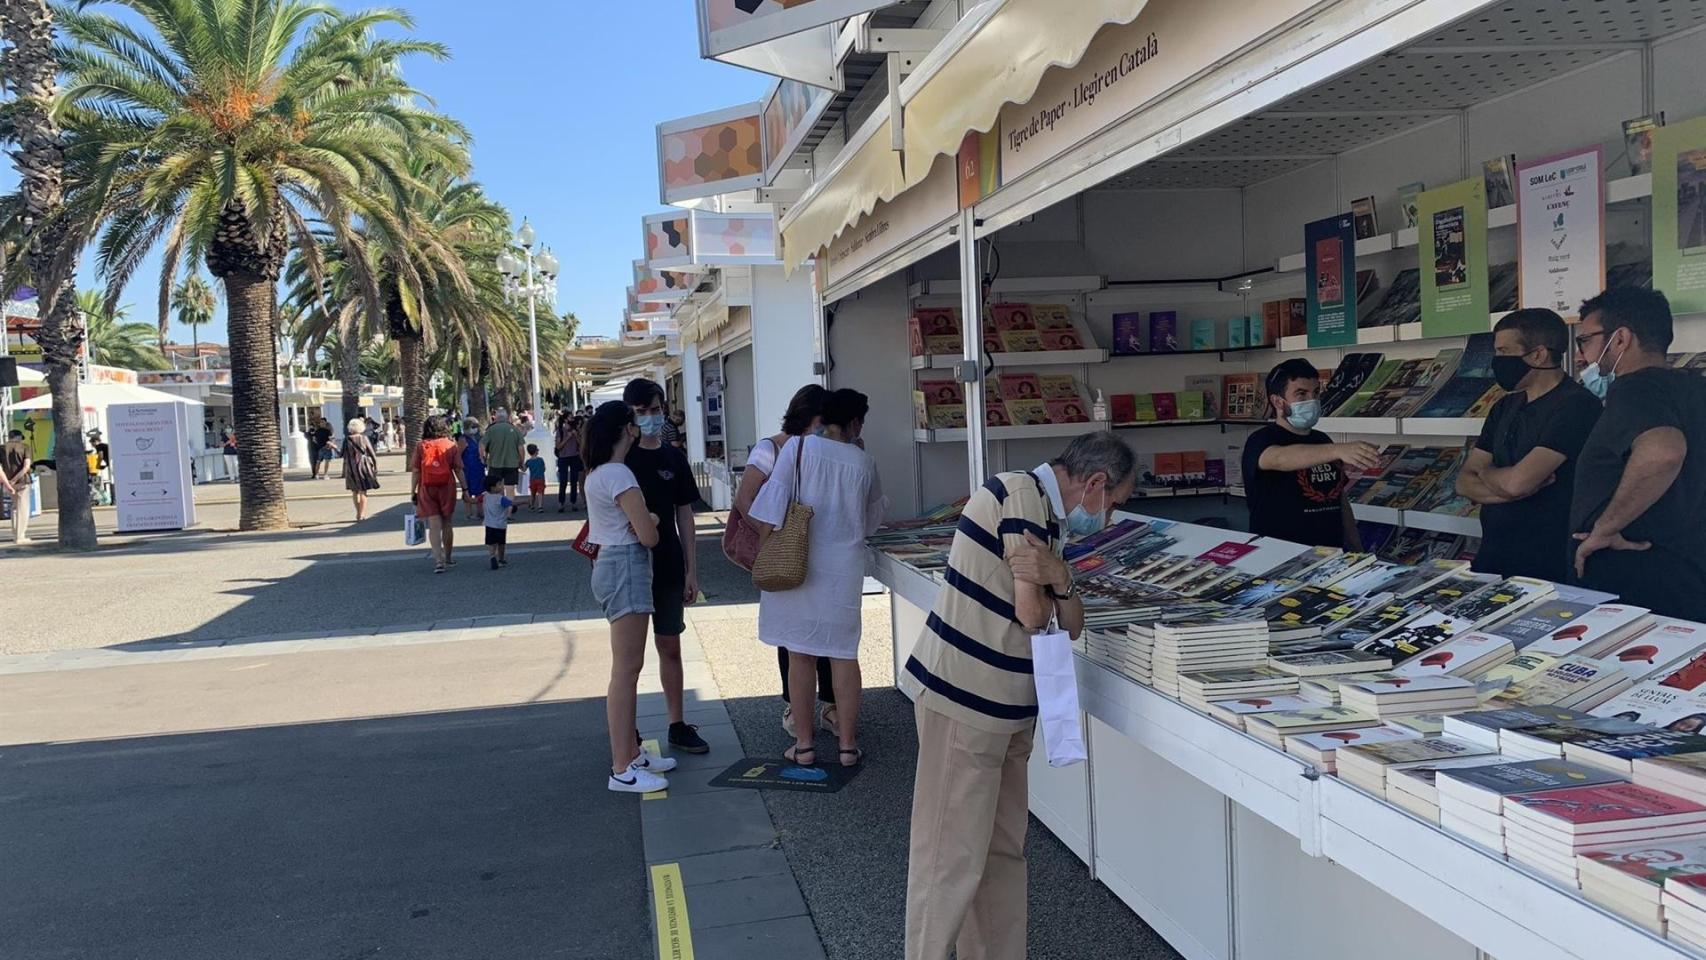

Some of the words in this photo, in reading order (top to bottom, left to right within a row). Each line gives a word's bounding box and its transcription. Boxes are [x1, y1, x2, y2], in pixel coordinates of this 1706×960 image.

[1008, 126, 1028, 152] Tigre
[1029, 116, 1039, 137] de
[1041, 101, 1066, 131] Paper
[1073, 72, 1103, 108] Llegir
[1104, 65, 1117, 87] en
[1120, 32, 1158, 77] Català
[1530, 175, 1544, 186] SOM
[1311, 463, 1332, 473] RED
[1311, 472, 1337, 482] FURY
[1559, 663, 1597, 677] CUBA
[1640, 689, 1679, 700] SENYALS
